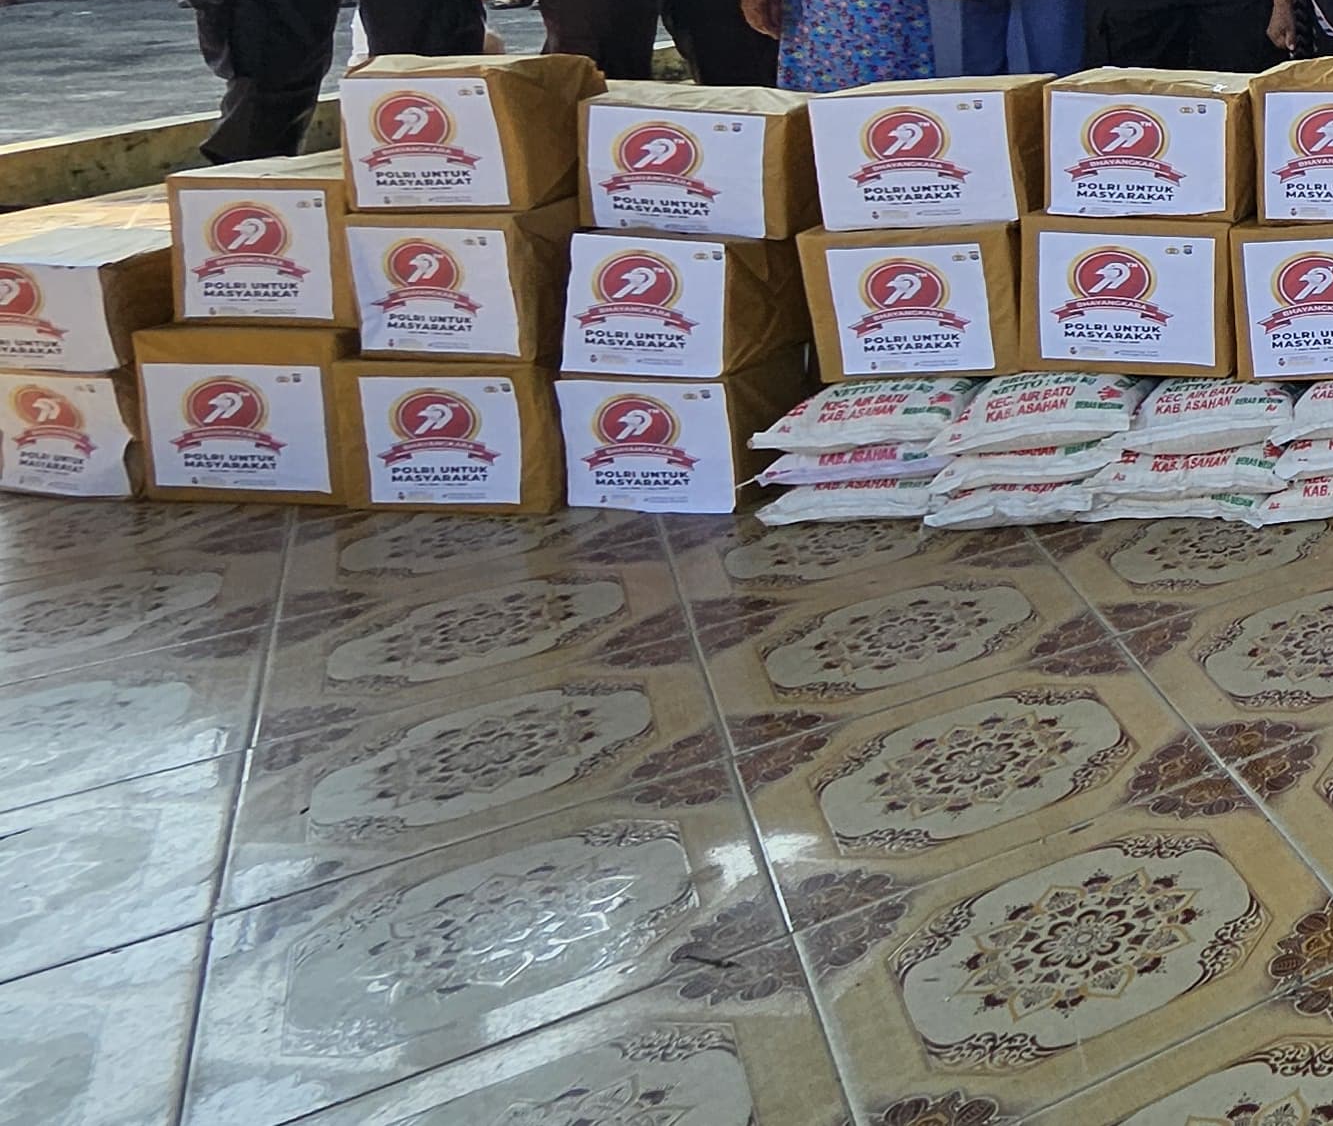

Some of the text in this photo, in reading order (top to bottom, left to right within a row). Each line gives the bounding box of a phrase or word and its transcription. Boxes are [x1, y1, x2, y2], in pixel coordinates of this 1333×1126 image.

[1090, 159, 1160, 169] BHAYANGKARA
[863, 183, 960, 195] POLRI UNTUK
[1077, 182, 1173, 194] POLRI UNTUK
[1286, 182, 1327, 191] POLRI
[863, 191, 961, 203] MASYARAKAT
[1076, 190, 1175, 202] MASYARAKAT
[204, 281, 298, 291] POLRI UNTUK
[203, 289, 299, 299] MASYARAKAT
[1064, 322, 1161, 333] POLRI UNTUK
[585, 329, 685, 342] POLRI UNTUK
[1064, 330, 1162, 341] MASYARAKAT
[584, 337, 686, 350] MASYARAKAT
[1016, 393, 1041, 403] AIR
[1042, 386, 1076, 398] BATU
[1186, 385, 1243, 399] AIR BATU
[852, 397, 874, 407] AIR
[874, 394, 909, 404] BATU
[1184, 395, 1232, 412] ASAHAN
[1234, 397, 1256, 406] BERAS
[848, 405, 897, 421] ASAHAN
[1016, 398, 1069, 416] ASAHAN
[1183, 455, 1228, 469] ASAHAN
[595, 469, 689, 480] POLRI UNTUK
[595, 477, 691, 487] MASYARAKAT
[1303, 484, 1330, 497] KAB.
